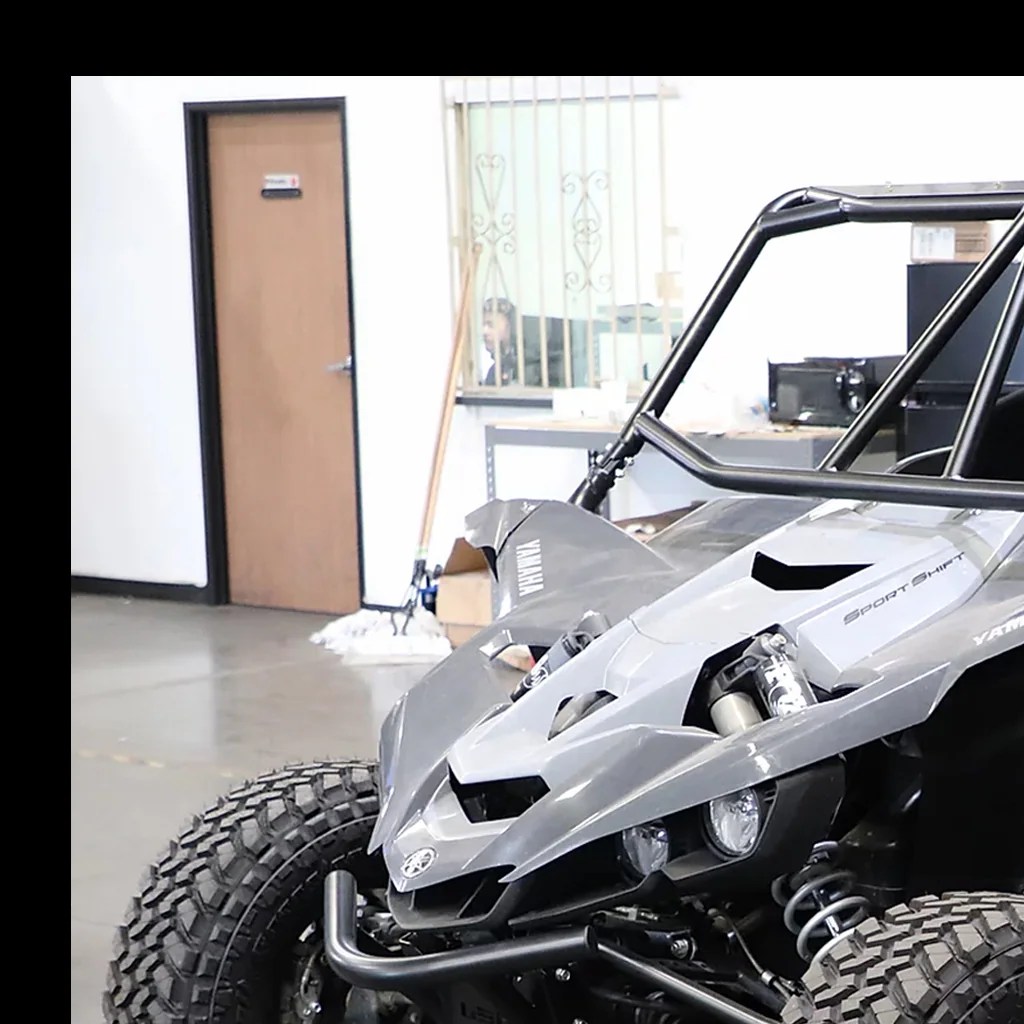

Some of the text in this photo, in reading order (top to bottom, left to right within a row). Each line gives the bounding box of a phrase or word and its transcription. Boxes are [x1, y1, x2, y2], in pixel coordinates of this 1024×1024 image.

[516, 538, 544, 597] YAMAHA
[843, 551, 965, 625] SPORT SHIFT
